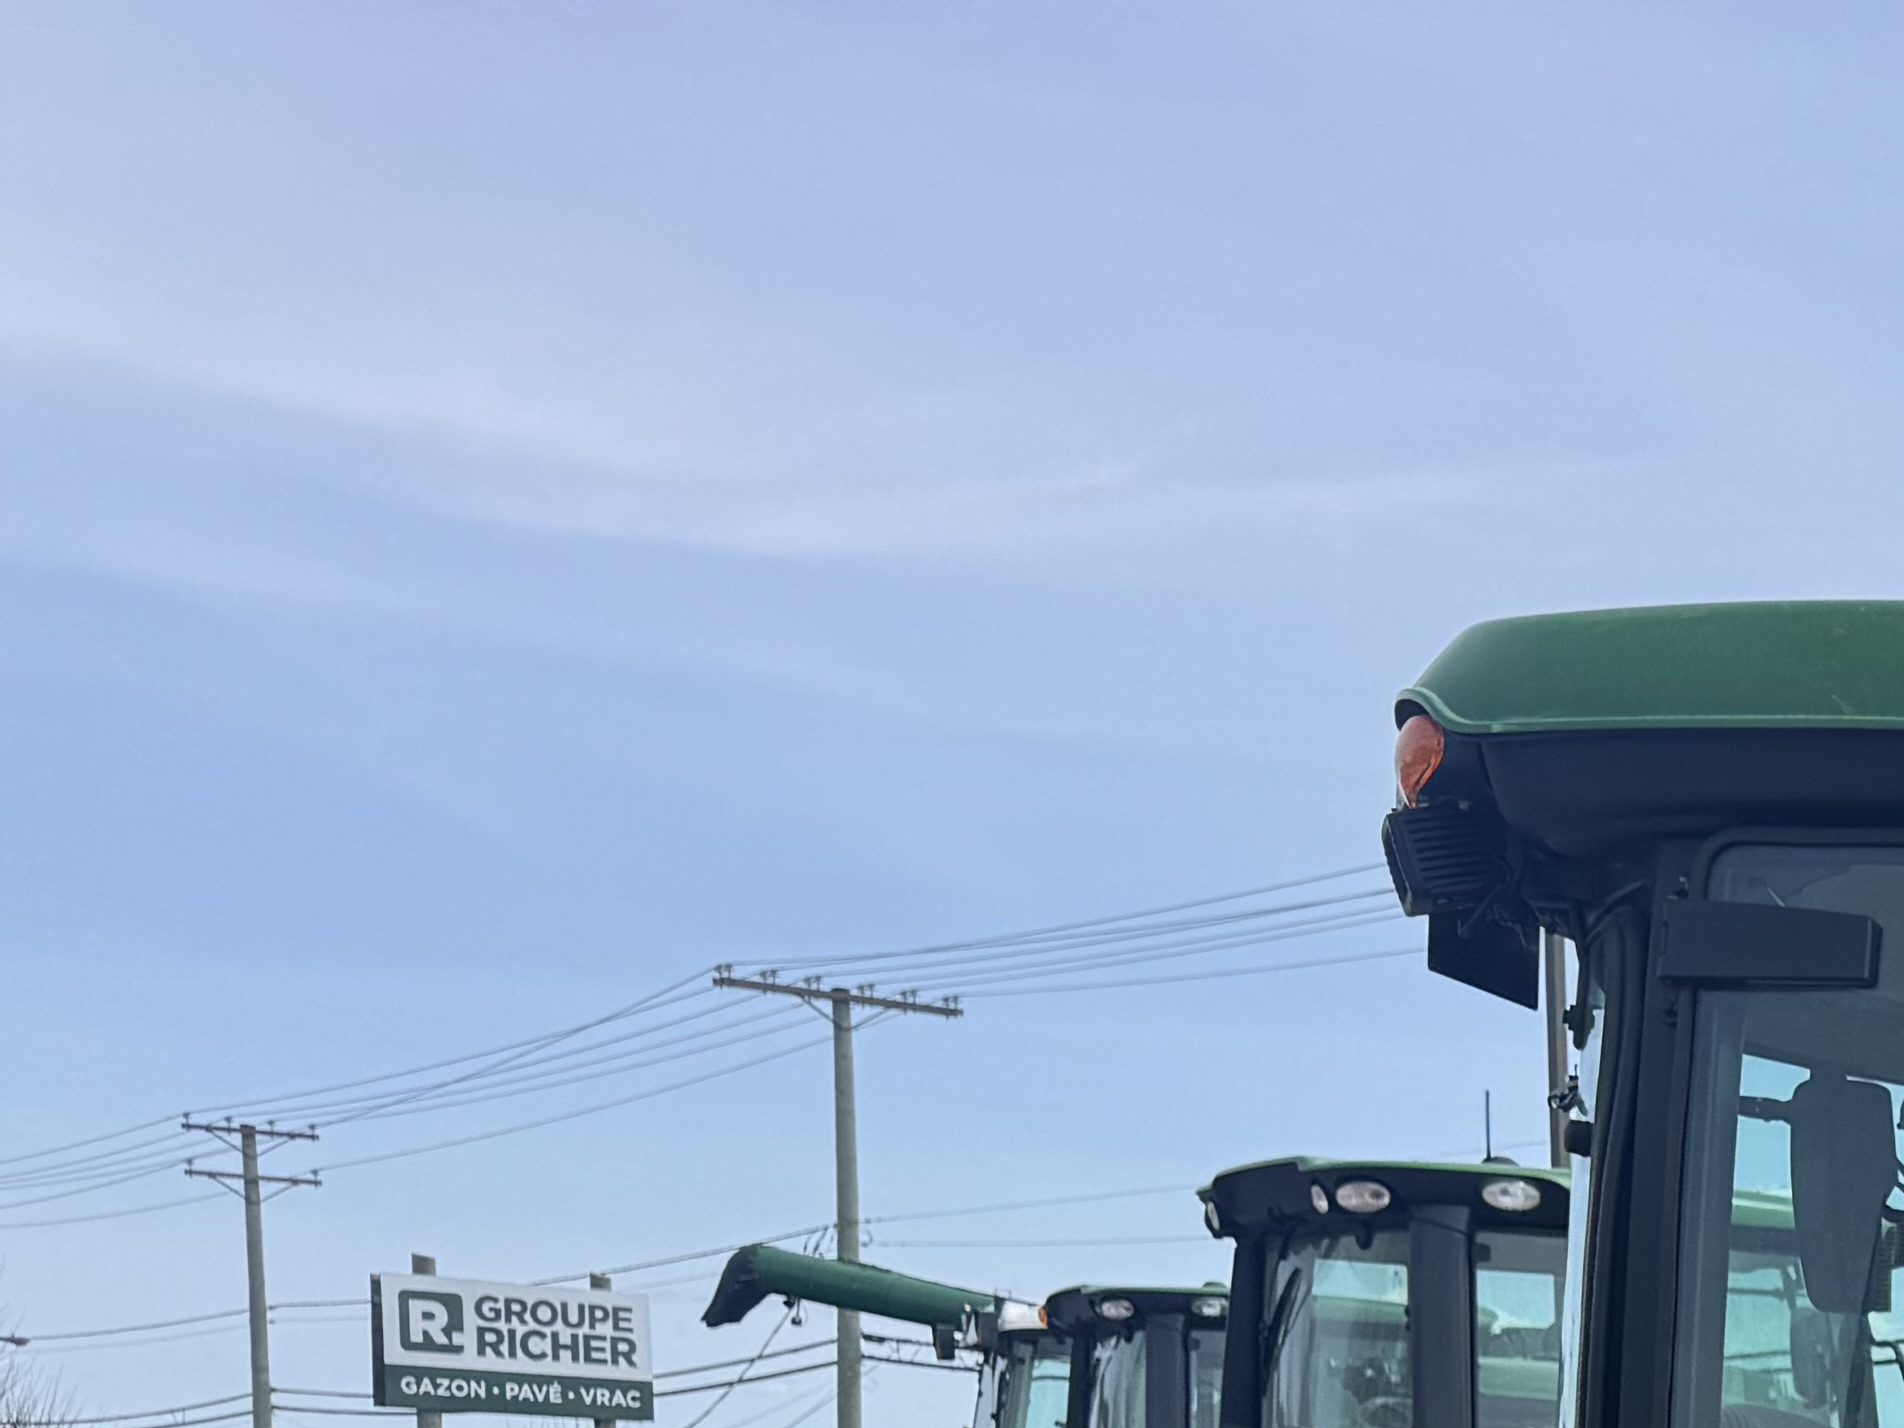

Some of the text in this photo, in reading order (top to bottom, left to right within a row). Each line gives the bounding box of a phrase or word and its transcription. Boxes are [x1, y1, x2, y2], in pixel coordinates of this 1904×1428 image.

[474, 1296, 635, 1334] GROUPE
[476, 1325, 638, 1369] RICHER
[400, 1375, 642, 1409] GAZON PAVÉ VRAC
